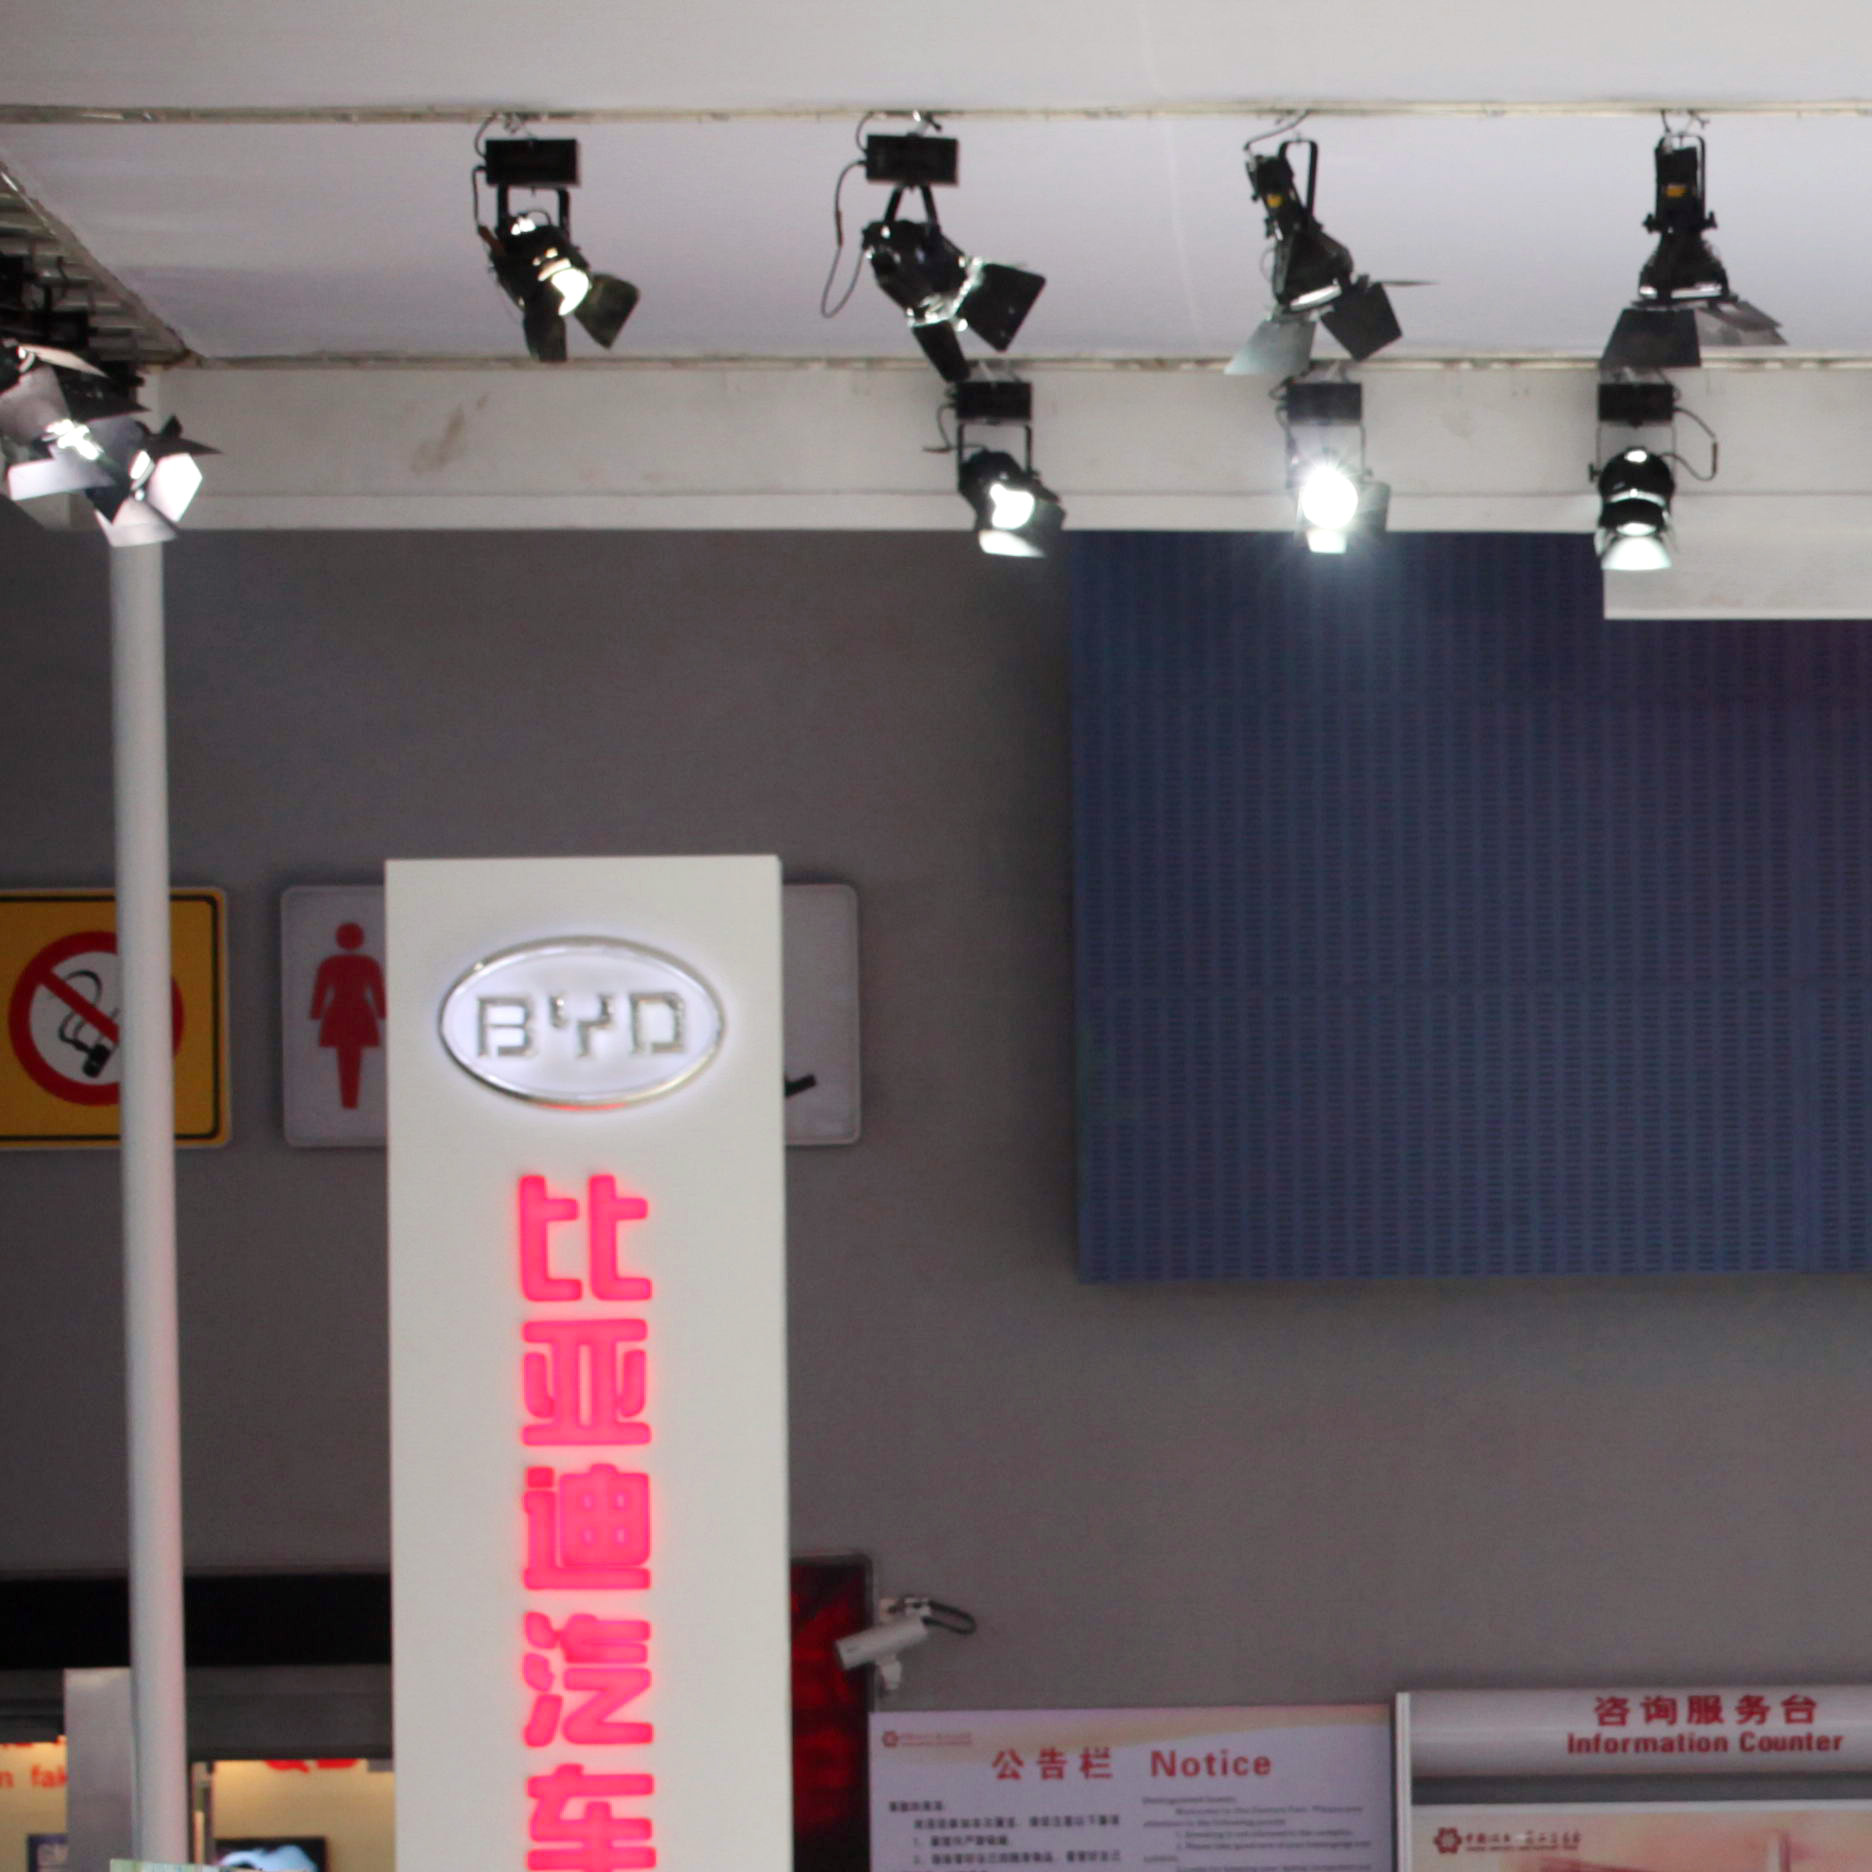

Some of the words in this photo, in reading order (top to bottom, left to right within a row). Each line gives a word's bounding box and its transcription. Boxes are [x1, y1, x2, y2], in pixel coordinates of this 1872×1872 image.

[475, 991, 686, 1059] BYD
[1594, 1693, 1818, 1727] 咨询服务台
[1567, 1731, 1728, 1755] Information
[1739, 1730, 1844, 1753] Counter
[992, 1747, 1115, 1781] 公告栏
[1150, 1748, 1272, 1778] Notice
